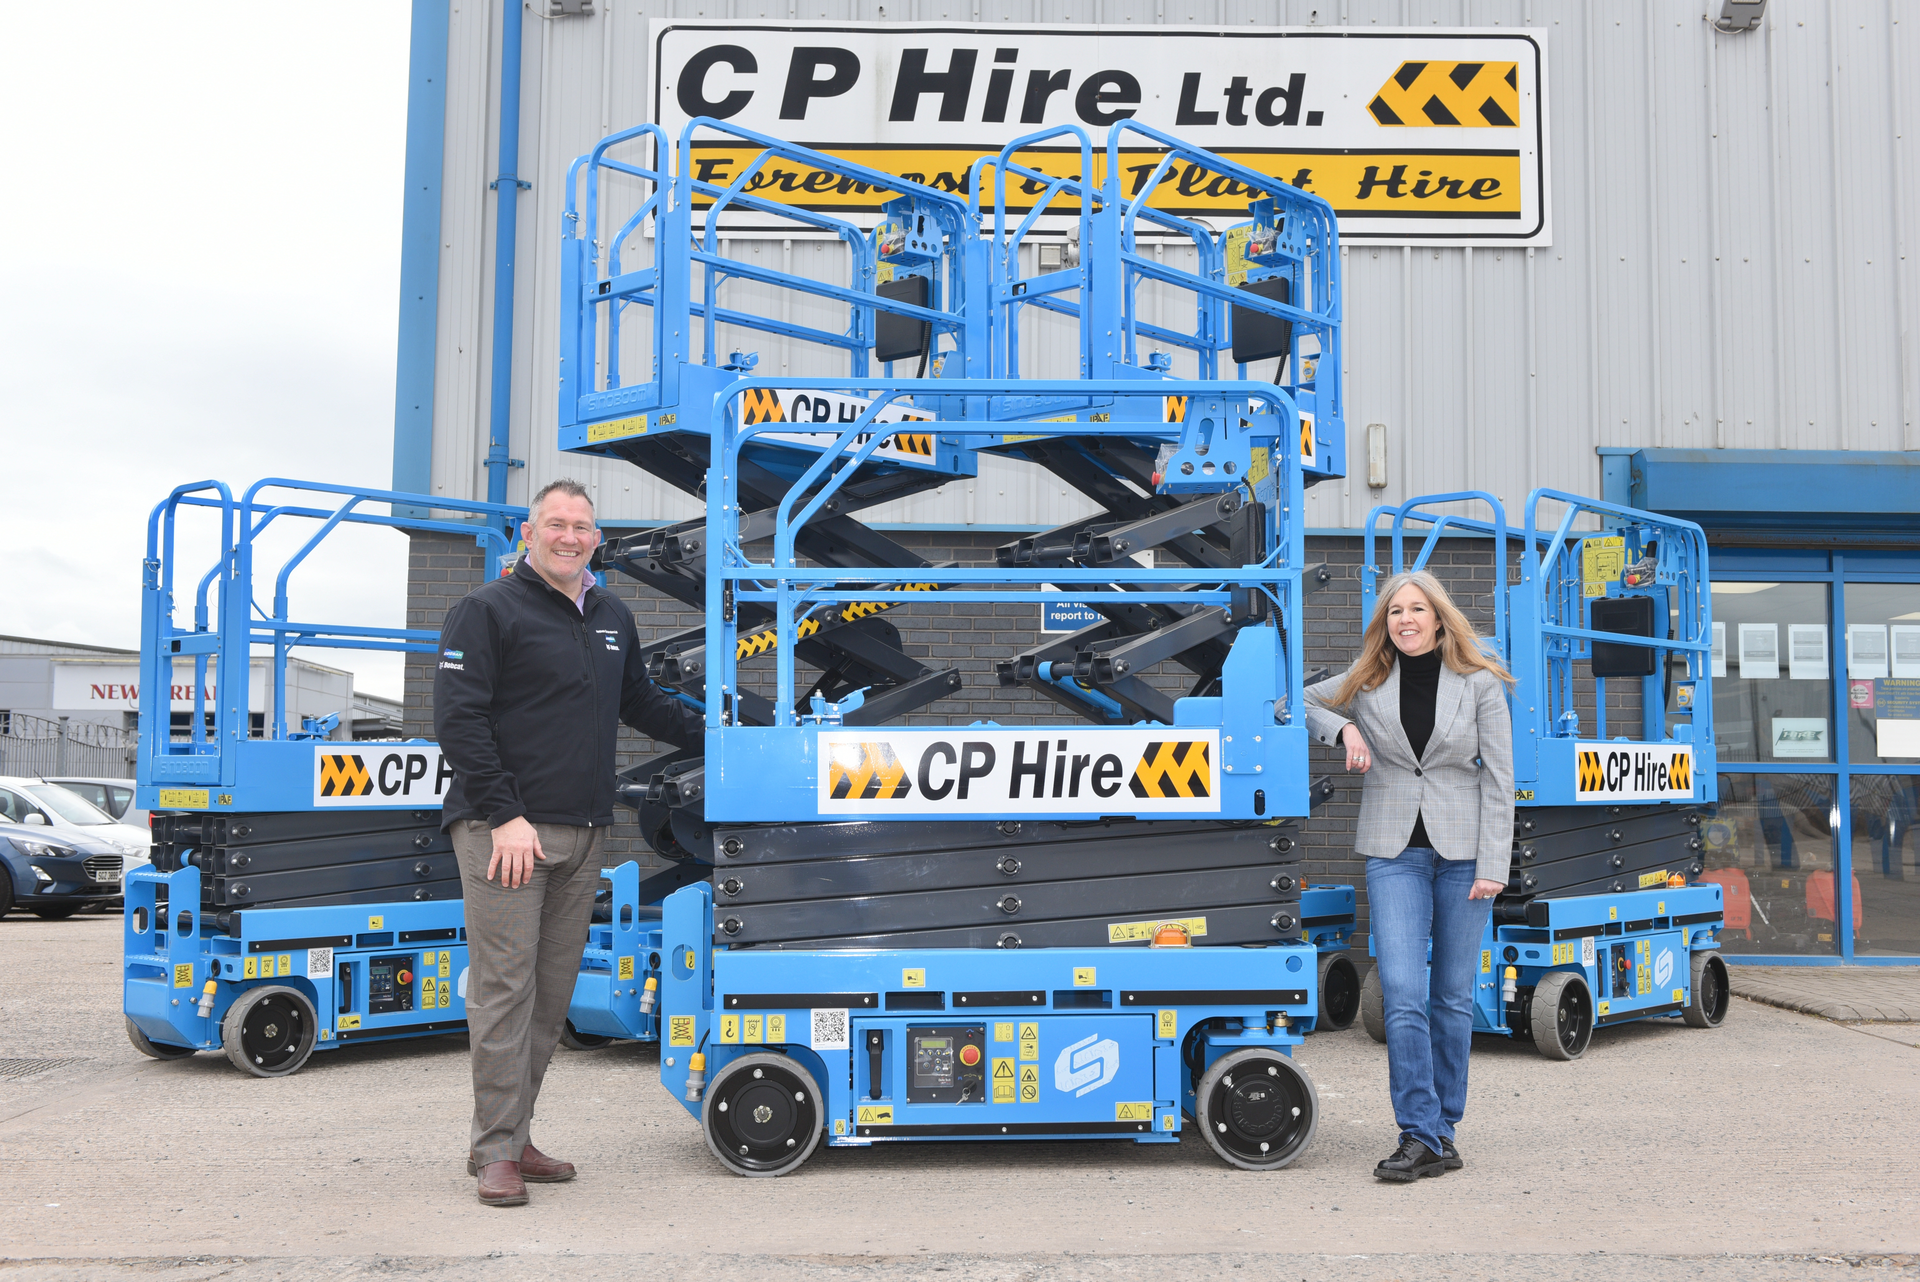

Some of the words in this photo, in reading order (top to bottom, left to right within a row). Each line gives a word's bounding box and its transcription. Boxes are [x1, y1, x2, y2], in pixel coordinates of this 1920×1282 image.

[677, 44, 759, 120] C
[779, 46, 861, 120] P
[889, 47, 1142, 125] Hire
[1175, 72, 1324, 127] Ltd.
[1126, 163, 1316, 199] Plant
[1355, 165, 1503, 201] Hire
[1050, 612, 1082, 621] report
[1084, 611, 1095, 620] to
[1883, 679, 1920, 687] WARNING
[378, 753, 428, 796] CP
[917, 741, 996, 801] CP
[1008, 739, 1123, 799] Hire
[1607, 751, 1631, 792] CP
[1634, 752, 1667, 792] Hire
[1514, 788, 1533, 800] PAF
